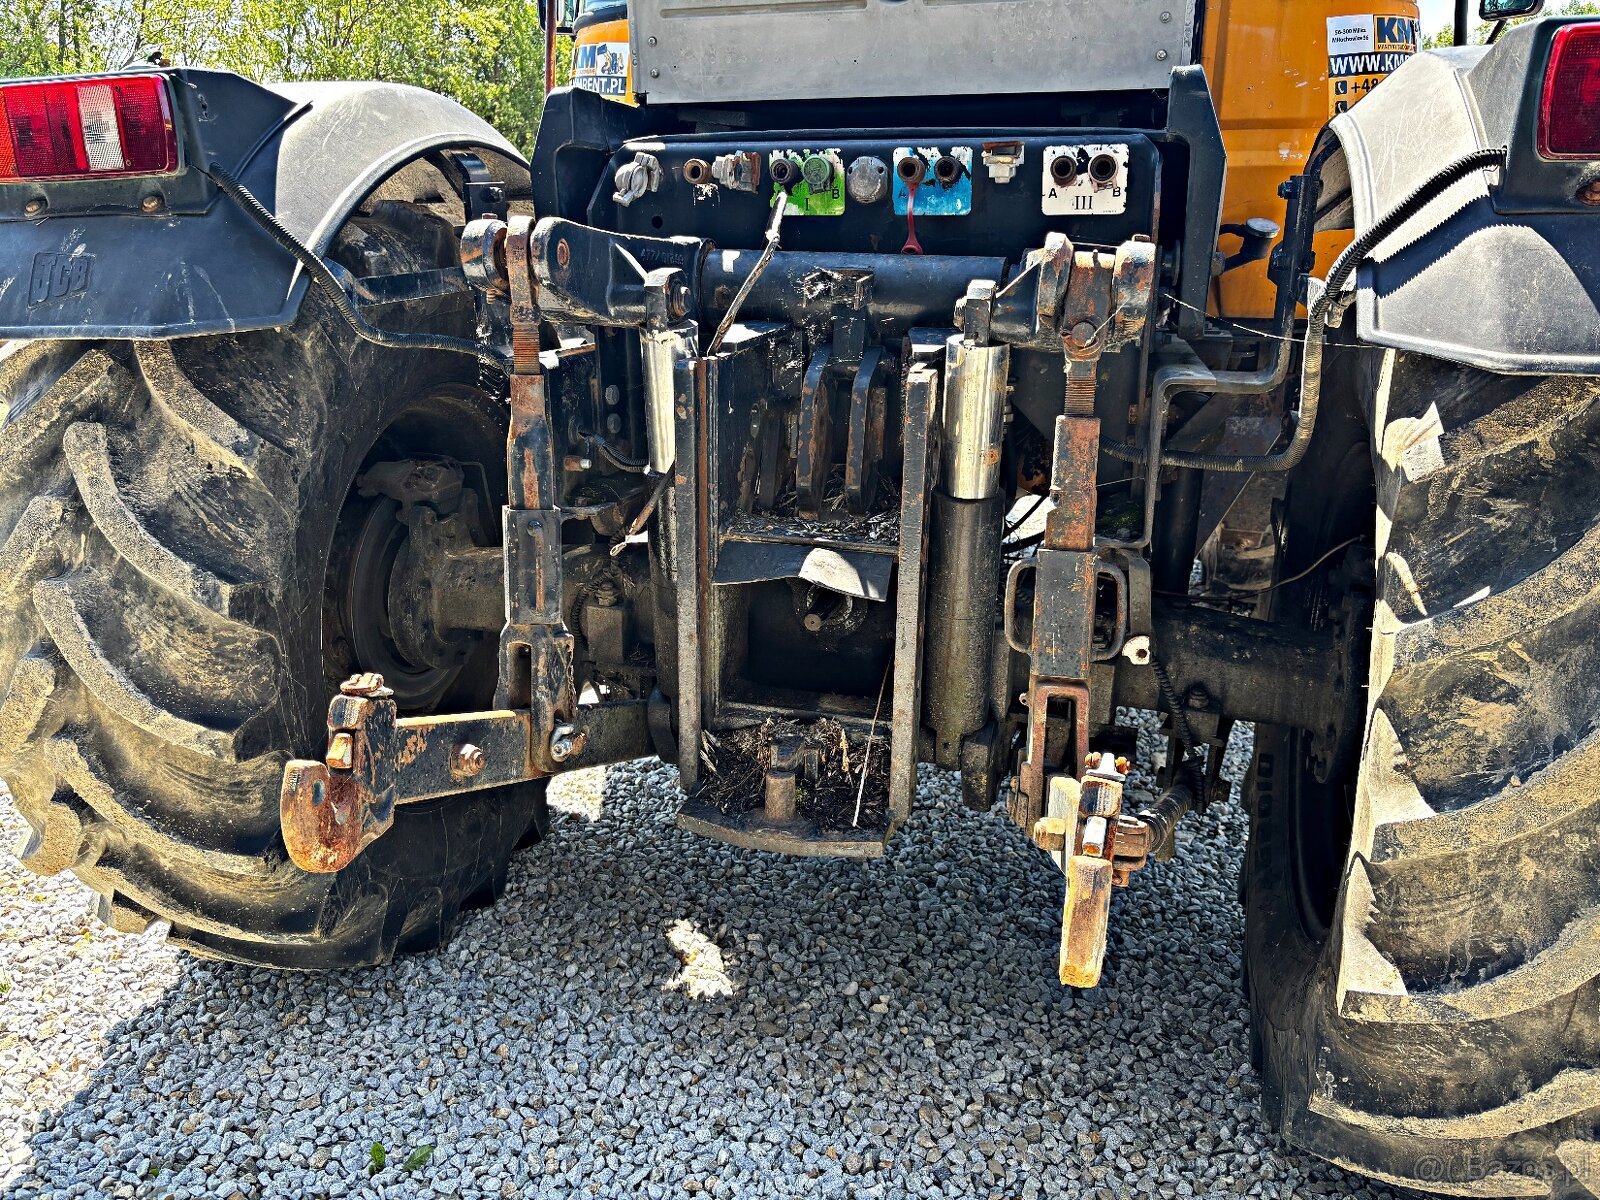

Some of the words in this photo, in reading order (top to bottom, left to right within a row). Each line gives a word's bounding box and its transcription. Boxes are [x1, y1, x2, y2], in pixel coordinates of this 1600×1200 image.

[832, 188, 840, 200] B
[1048, 187, 1058, 199] A
[1112, 186, 1121, 198] B
[29, 253, 92, 306] JCB
